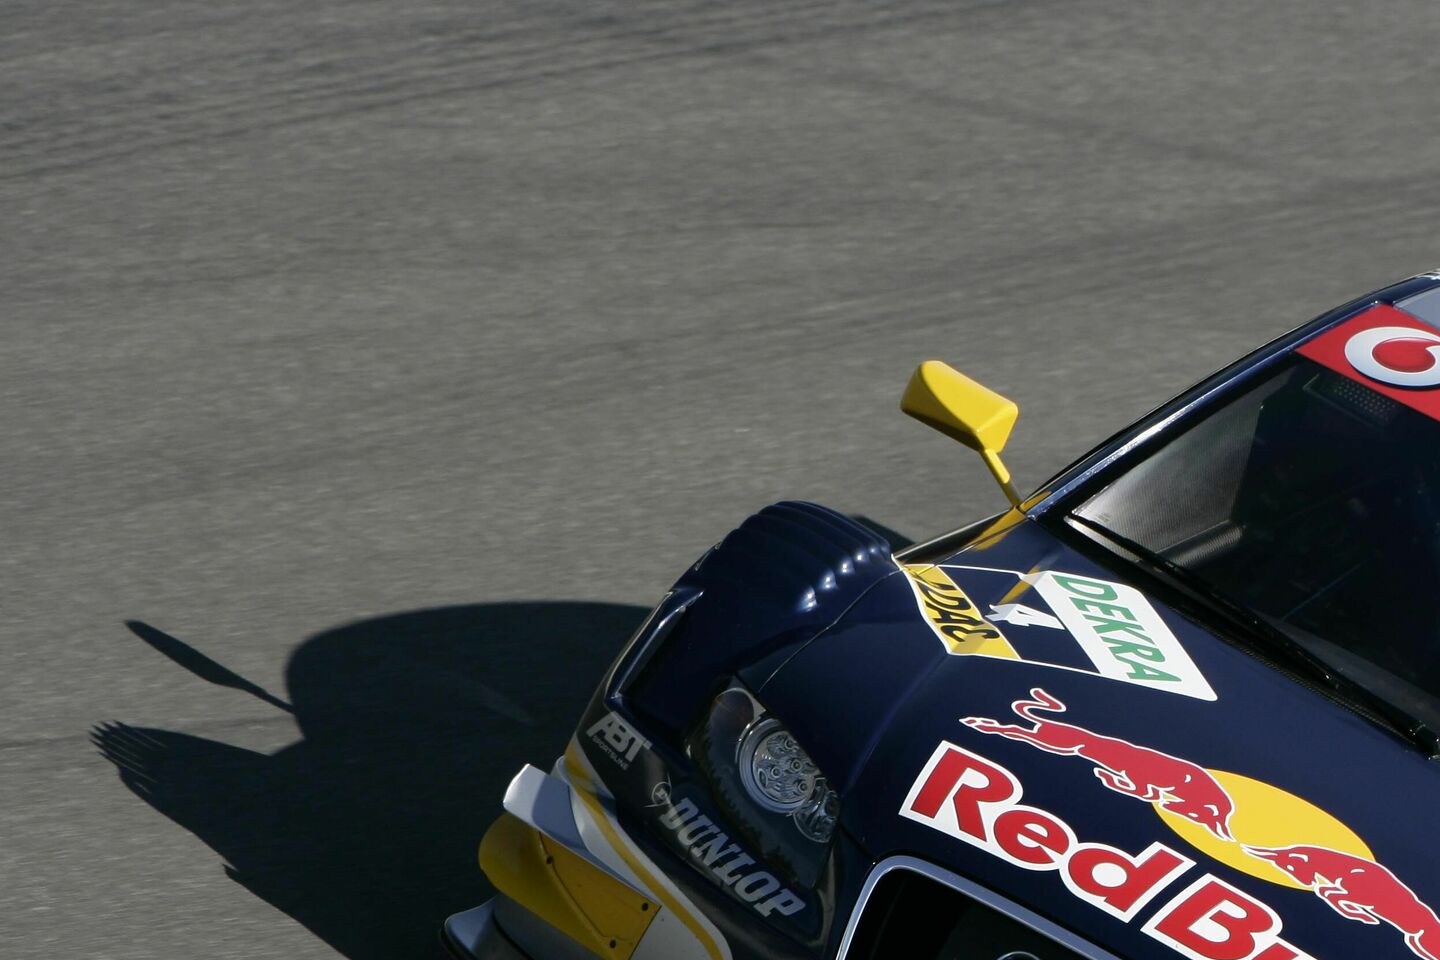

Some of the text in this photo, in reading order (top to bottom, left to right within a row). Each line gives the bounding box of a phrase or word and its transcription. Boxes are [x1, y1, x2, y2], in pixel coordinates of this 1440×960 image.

[984, 603, 1066, 631] 4
[1050, 574, 1183, 683] DEKRA
[586, 711, 653, 763] ABT
[659, 797, 807, 918] DUNLOP
[904, 744, 1190, 914] Red
